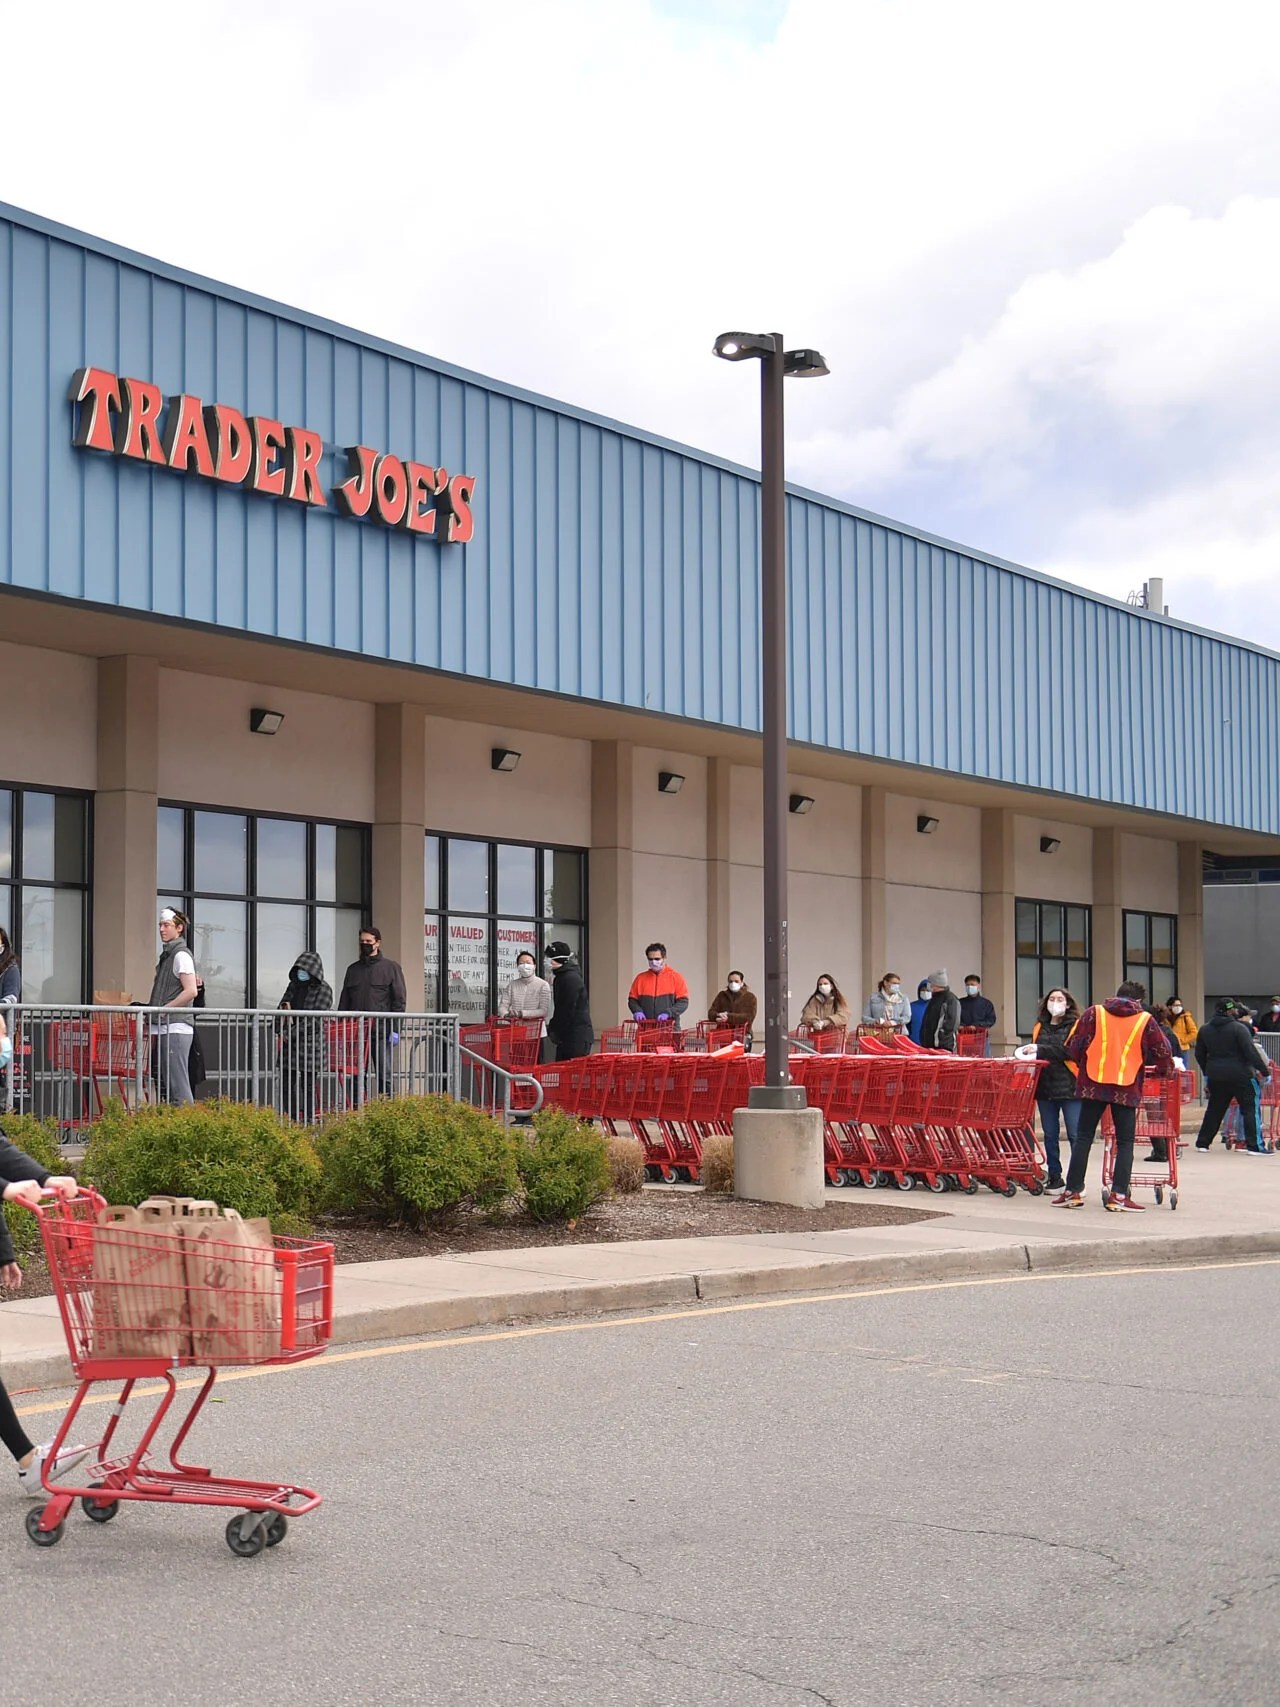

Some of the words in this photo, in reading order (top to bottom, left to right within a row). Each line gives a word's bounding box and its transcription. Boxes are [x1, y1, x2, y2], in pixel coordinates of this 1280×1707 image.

[75, 366, 327, 507] TRADER
[333, 445, 476, 545] JOE'S
[424, 924, 438, 937] UR
[450, 926, 484, 940] VALUED
[497, 929, 538, 944] CUSTOMERS
[457, 944, 471, 953] THIS
[472, 970, 485, 980] ANY
[499, 972, 515, 982] TEMS
